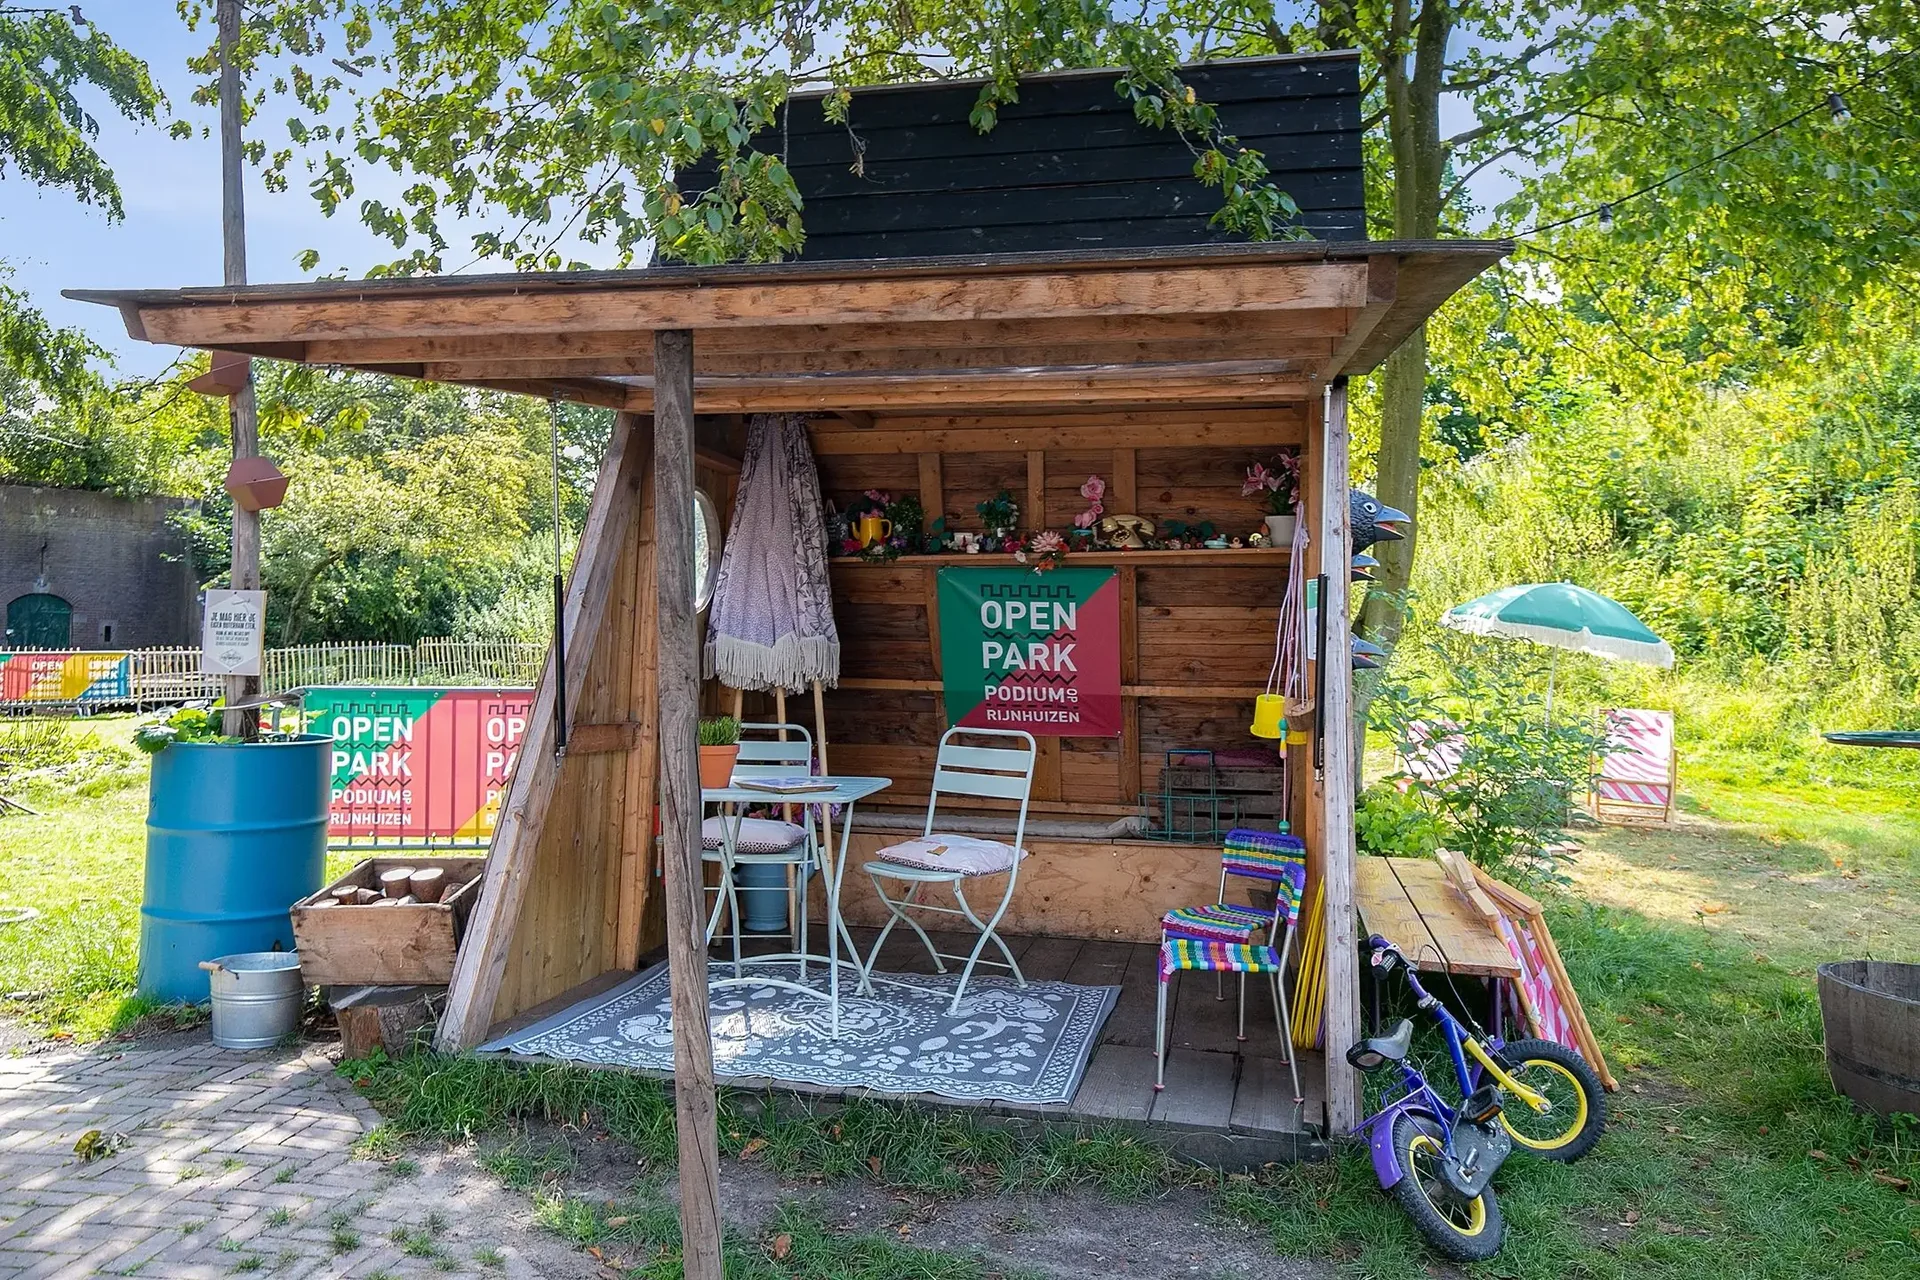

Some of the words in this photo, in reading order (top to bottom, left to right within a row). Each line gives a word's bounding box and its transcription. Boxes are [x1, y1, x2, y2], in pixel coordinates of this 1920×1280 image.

[981, 600, 1077, 631] OPEN
[982, 641, 1078, 672] PARK
[31, 660, 64, 671] OPEN
[88, 660, 119, 670] OPEN
[31, 670, 62, 681] PARK
[88, 670, 119, 680] PARK
[984, 685, 1064, 703] PODIUM
[1066, 688, 1078, 703] OP
[986, 709, 1080, 723] RIJNHUIZEN
[332, 716, 413, 742] OPEN
[486, 717, 526, 742] OP
[331, 751, 412, 776] PARK
[331, 789, 401, 805] PODIUM
[402, 790, 412, 805] OP
[331, 812, 412, 826] RIJNHUIZEN
